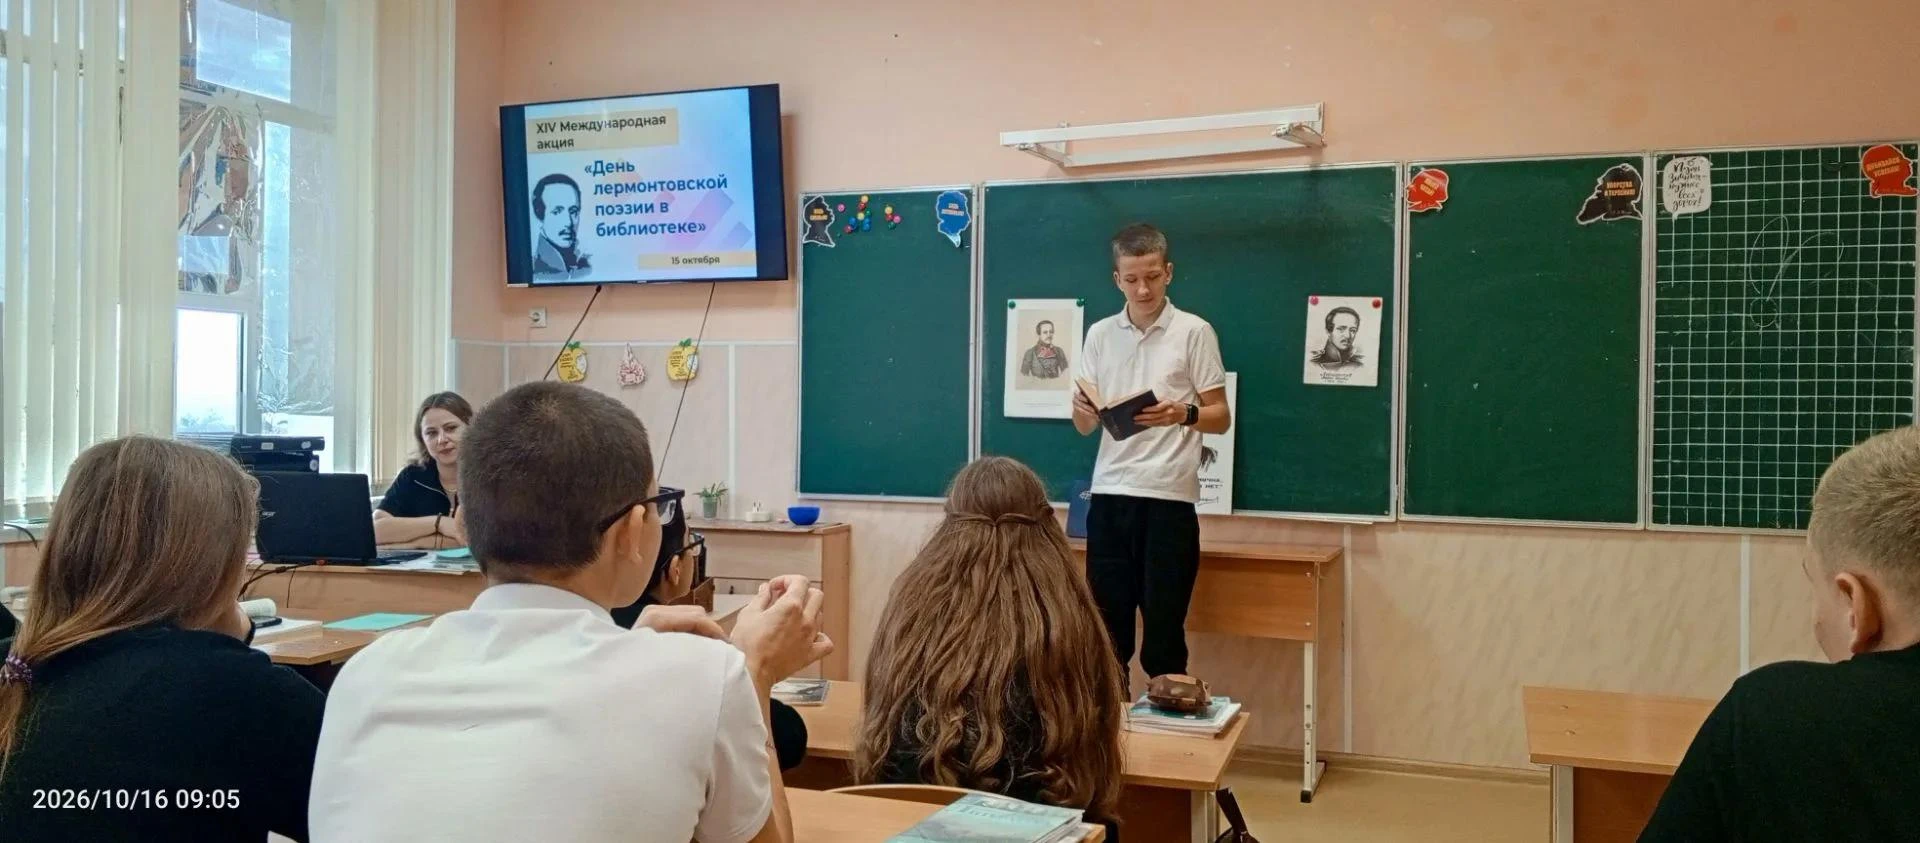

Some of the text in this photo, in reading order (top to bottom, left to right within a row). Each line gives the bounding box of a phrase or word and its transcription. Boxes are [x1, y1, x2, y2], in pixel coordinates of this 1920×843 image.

[536, 114, 667, 134] XIV Международная
[536, 138, 574, 150] акция
[584, 160, 635, 176] «День
[593, 174, 728, 197] лермонтовской
[595, 201, 669, 217] поэзии в
[596, 221, 706, 237] библиотеке»
[671, 255, 720, 266] 15 октября
